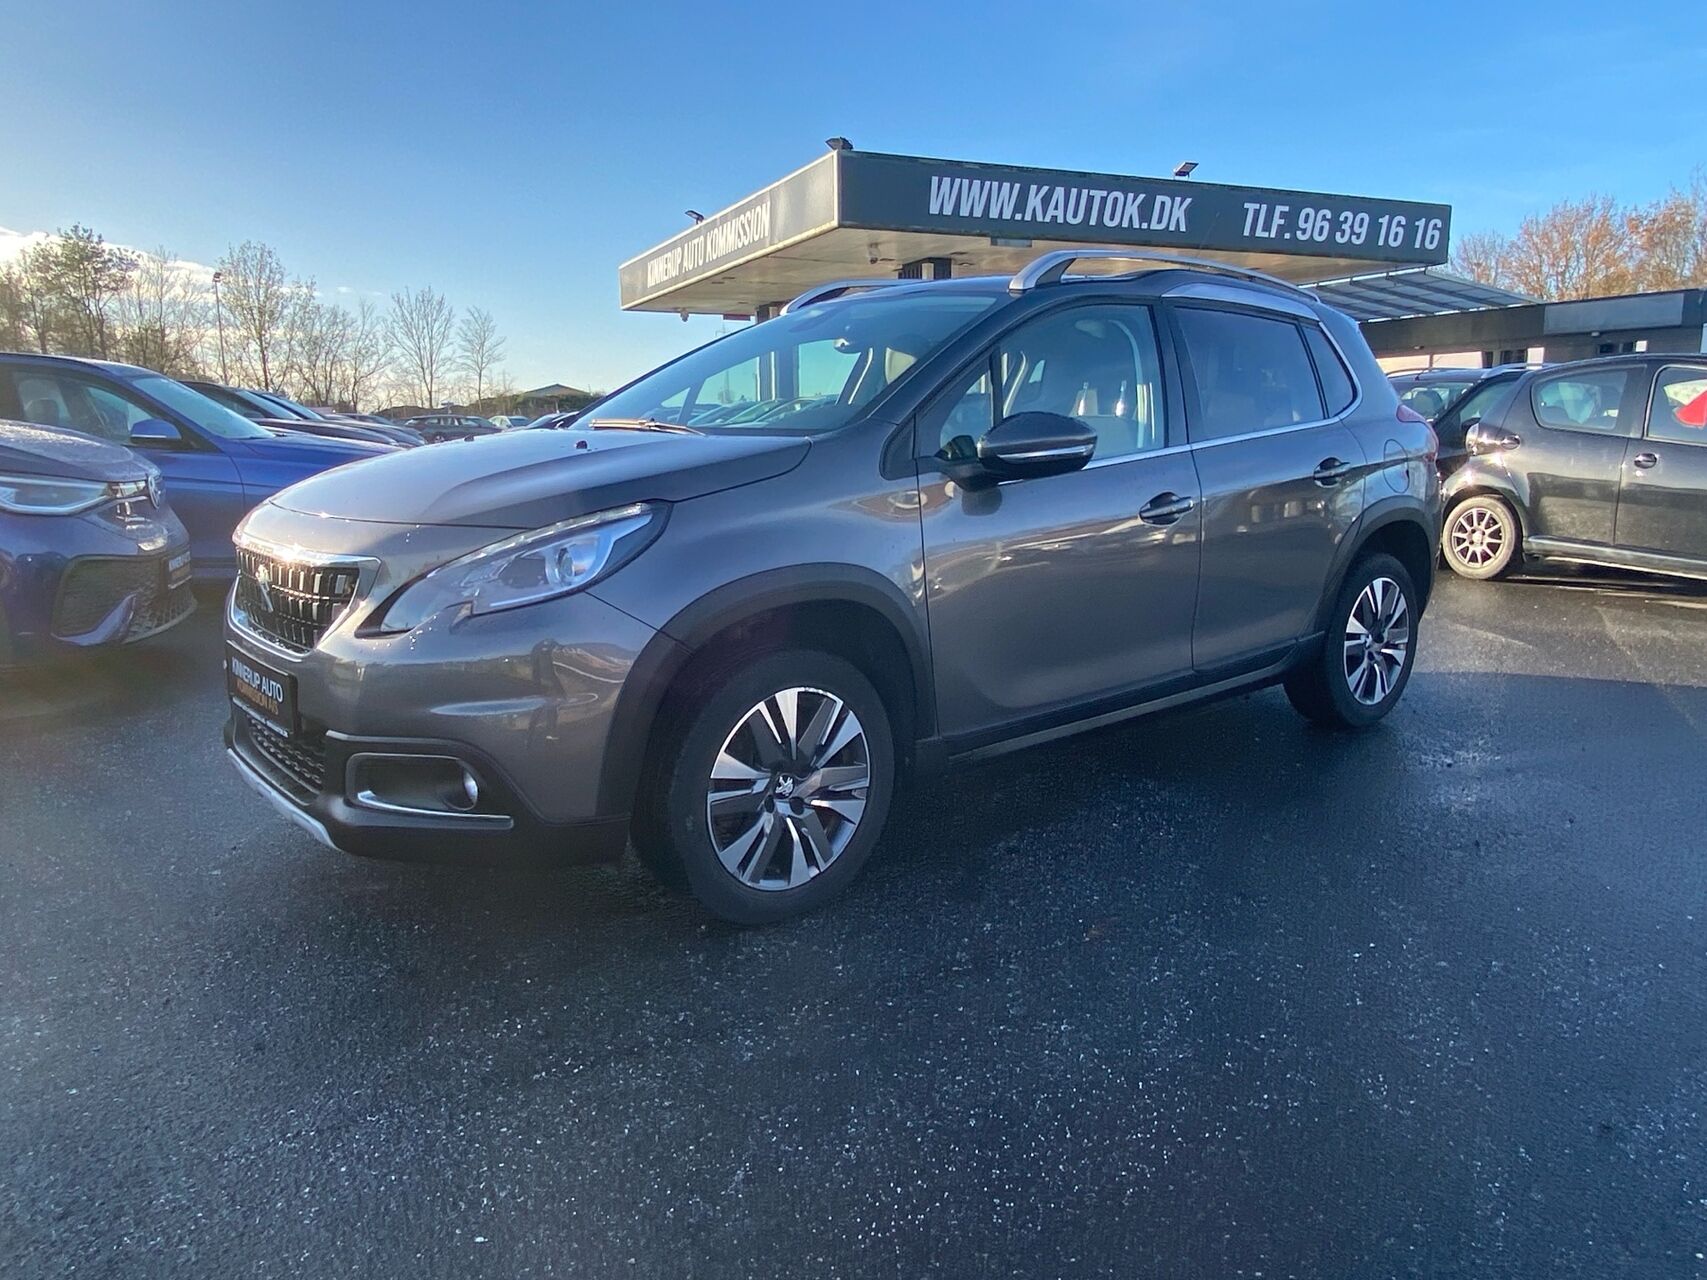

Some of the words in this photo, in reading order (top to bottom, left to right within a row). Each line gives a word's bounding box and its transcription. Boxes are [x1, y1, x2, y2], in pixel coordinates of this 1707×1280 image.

[929, 176, 1192, 233] WWW.KAUTOK.DK
[1242, 201, 1290, 240] TLF.
[1296, 206, 1330, 242] 96
[1334, 211, 1370, 245] 39
[1378, 214, 1406, 248] 16
[1414, 217, 1443, 250] 16
[648, 247, 682, 288] KINNERUP
[683, 236, 704, 272] AUTO
[707, 202, 770, 262] KOMMISSION
[262, 676, 283, 702] AUTO
